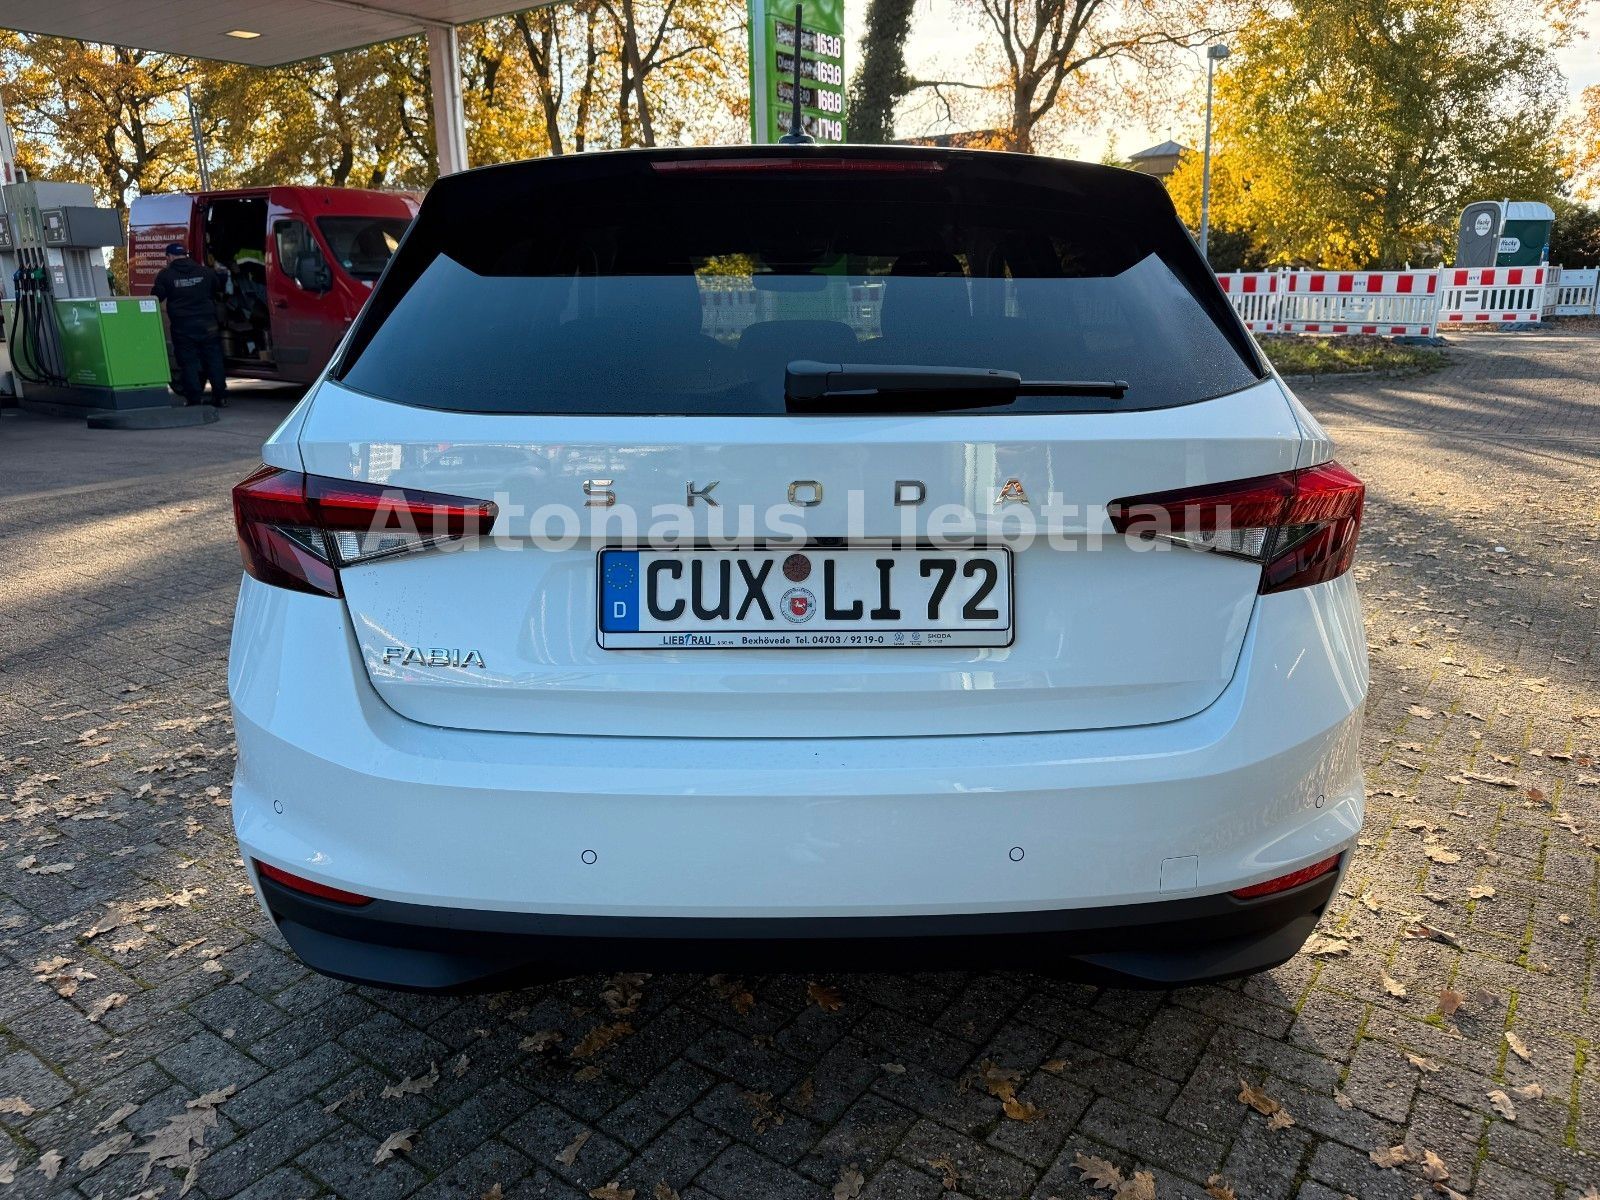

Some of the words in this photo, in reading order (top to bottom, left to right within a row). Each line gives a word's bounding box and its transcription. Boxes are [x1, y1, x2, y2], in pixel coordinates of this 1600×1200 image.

[72, 307, 80, 325] 2
[646, 559, 775, 621] CUX
[919, 559, 999, 620] 72
[613, 602, 627, 618] D
[663, 634, 712, 646] LIEBTRAU
[742, 636, 791, 645] Bexhövede
[795, 636, 810, 645] Tel.
[812, 636, 841, 644] 04703
[382, 645, 487, 669] FABIA
